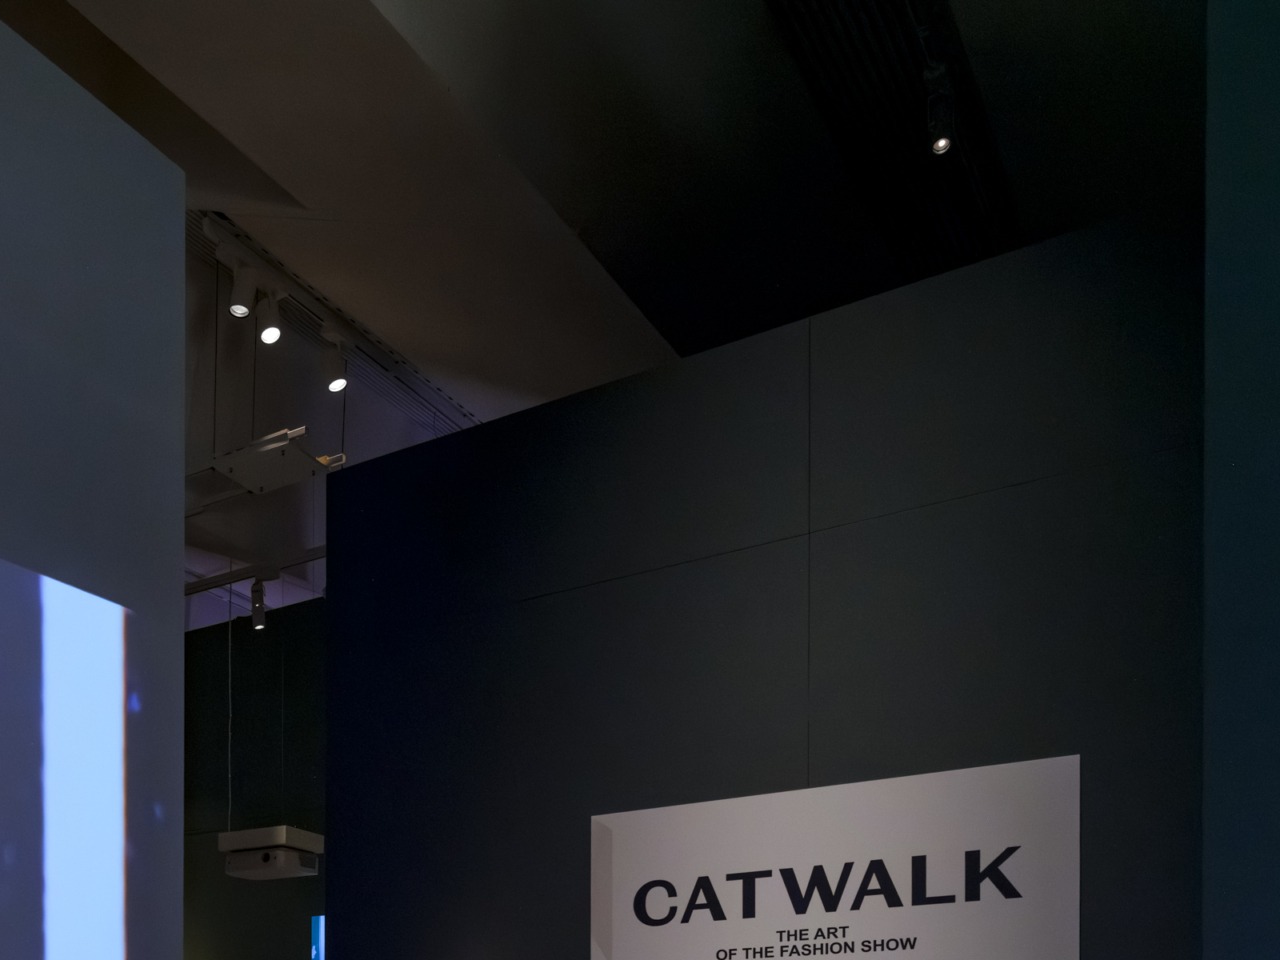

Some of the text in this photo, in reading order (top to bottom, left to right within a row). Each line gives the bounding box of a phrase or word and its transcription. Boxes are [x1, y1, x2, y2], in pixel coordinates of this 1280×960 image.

[633, 845, 1023, 927] CATWALK
[775, 925, 850, 943] THE ART
[715, 936, 918, 960] OF THE FASHION SHOW
